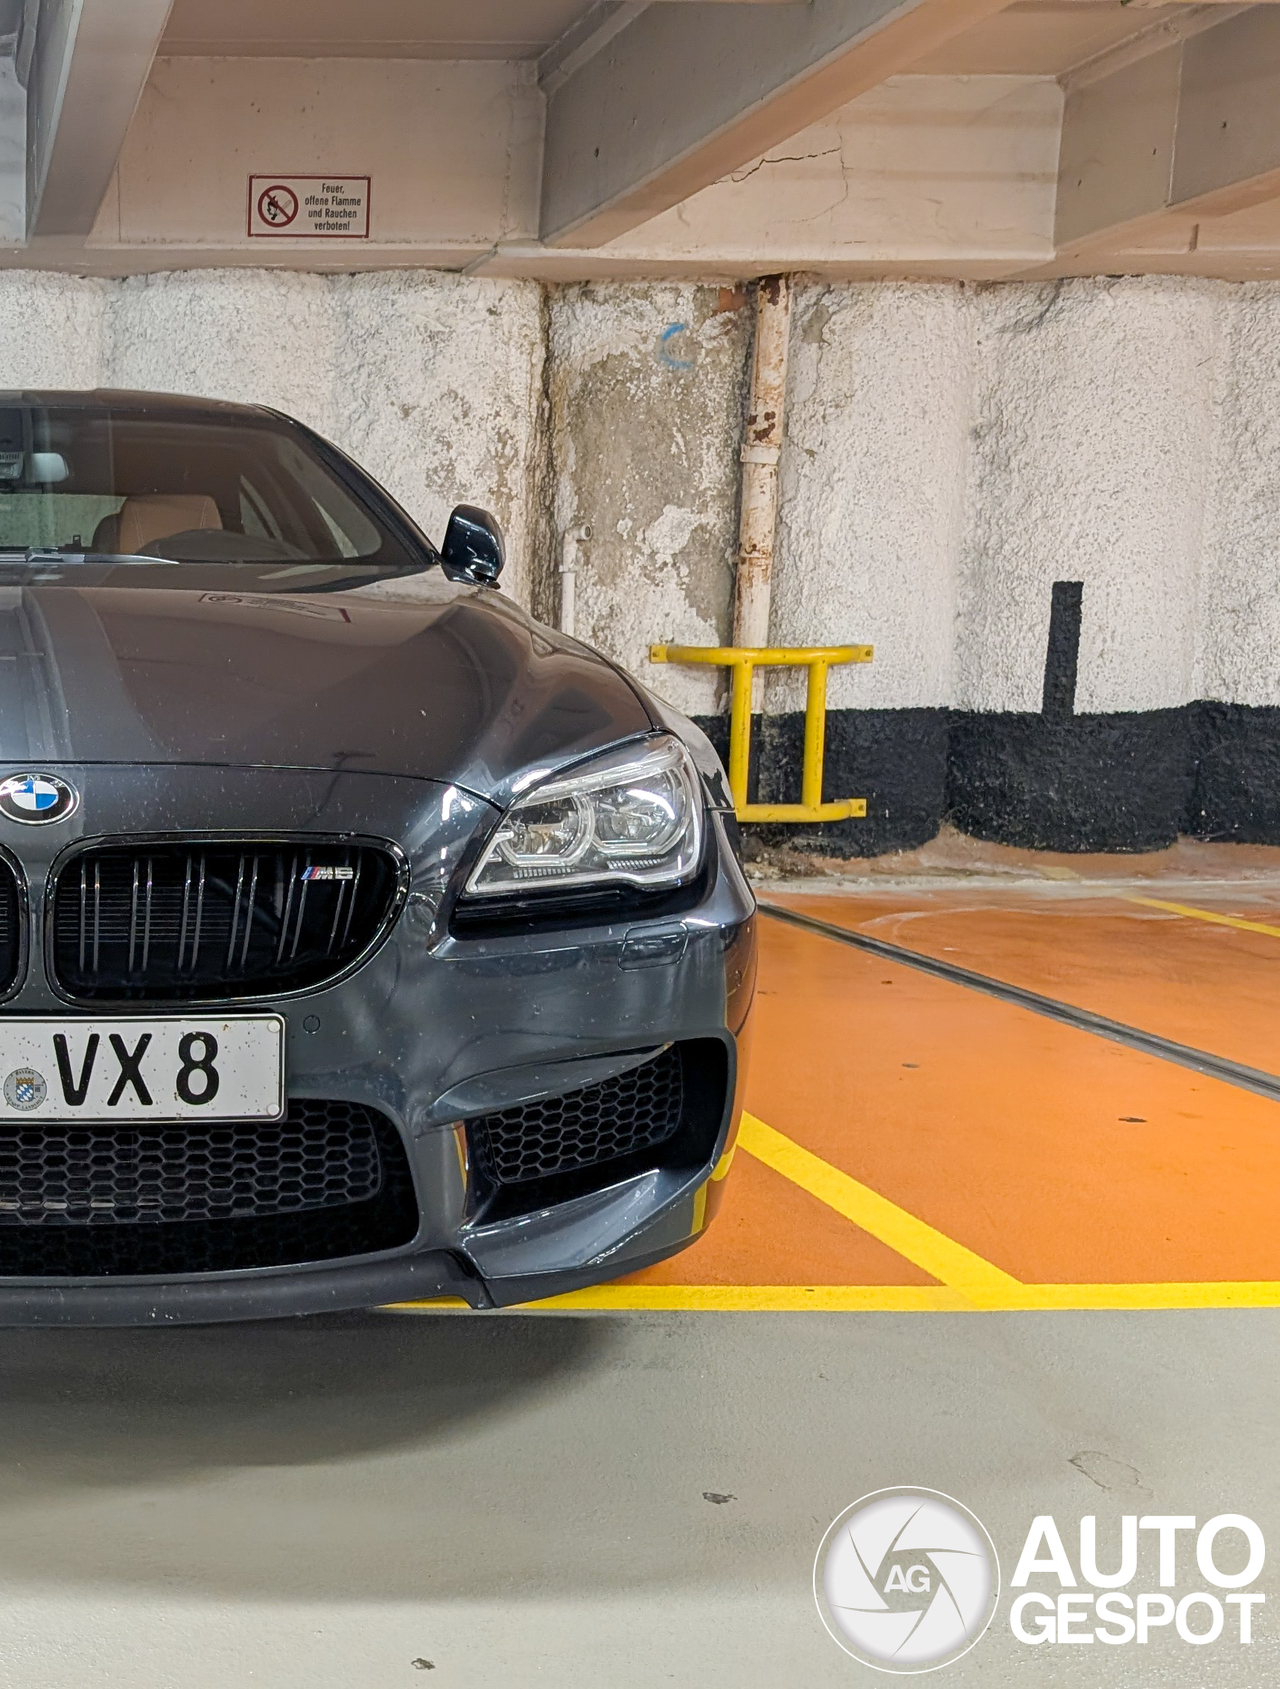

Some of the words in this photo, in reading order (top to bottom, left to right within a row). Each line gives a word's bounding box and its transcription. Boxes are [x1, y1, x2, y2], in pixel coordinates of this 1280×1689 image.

[322, 183, 345, 194] Feuer,
[304, 195, 329, 206] offene
[331, 196, 362, 206] Flamme
[308, 208, 322, 218] und
[325, 208, 357, 218] Rauchen
[314, 221, 350, 231] verboten!
[7, 774, 67, 789] MW
[313, 866, 354, 880] M6
[53, 1033, 153, 1107] VX
[175, 1031, 220, 1106] 8
